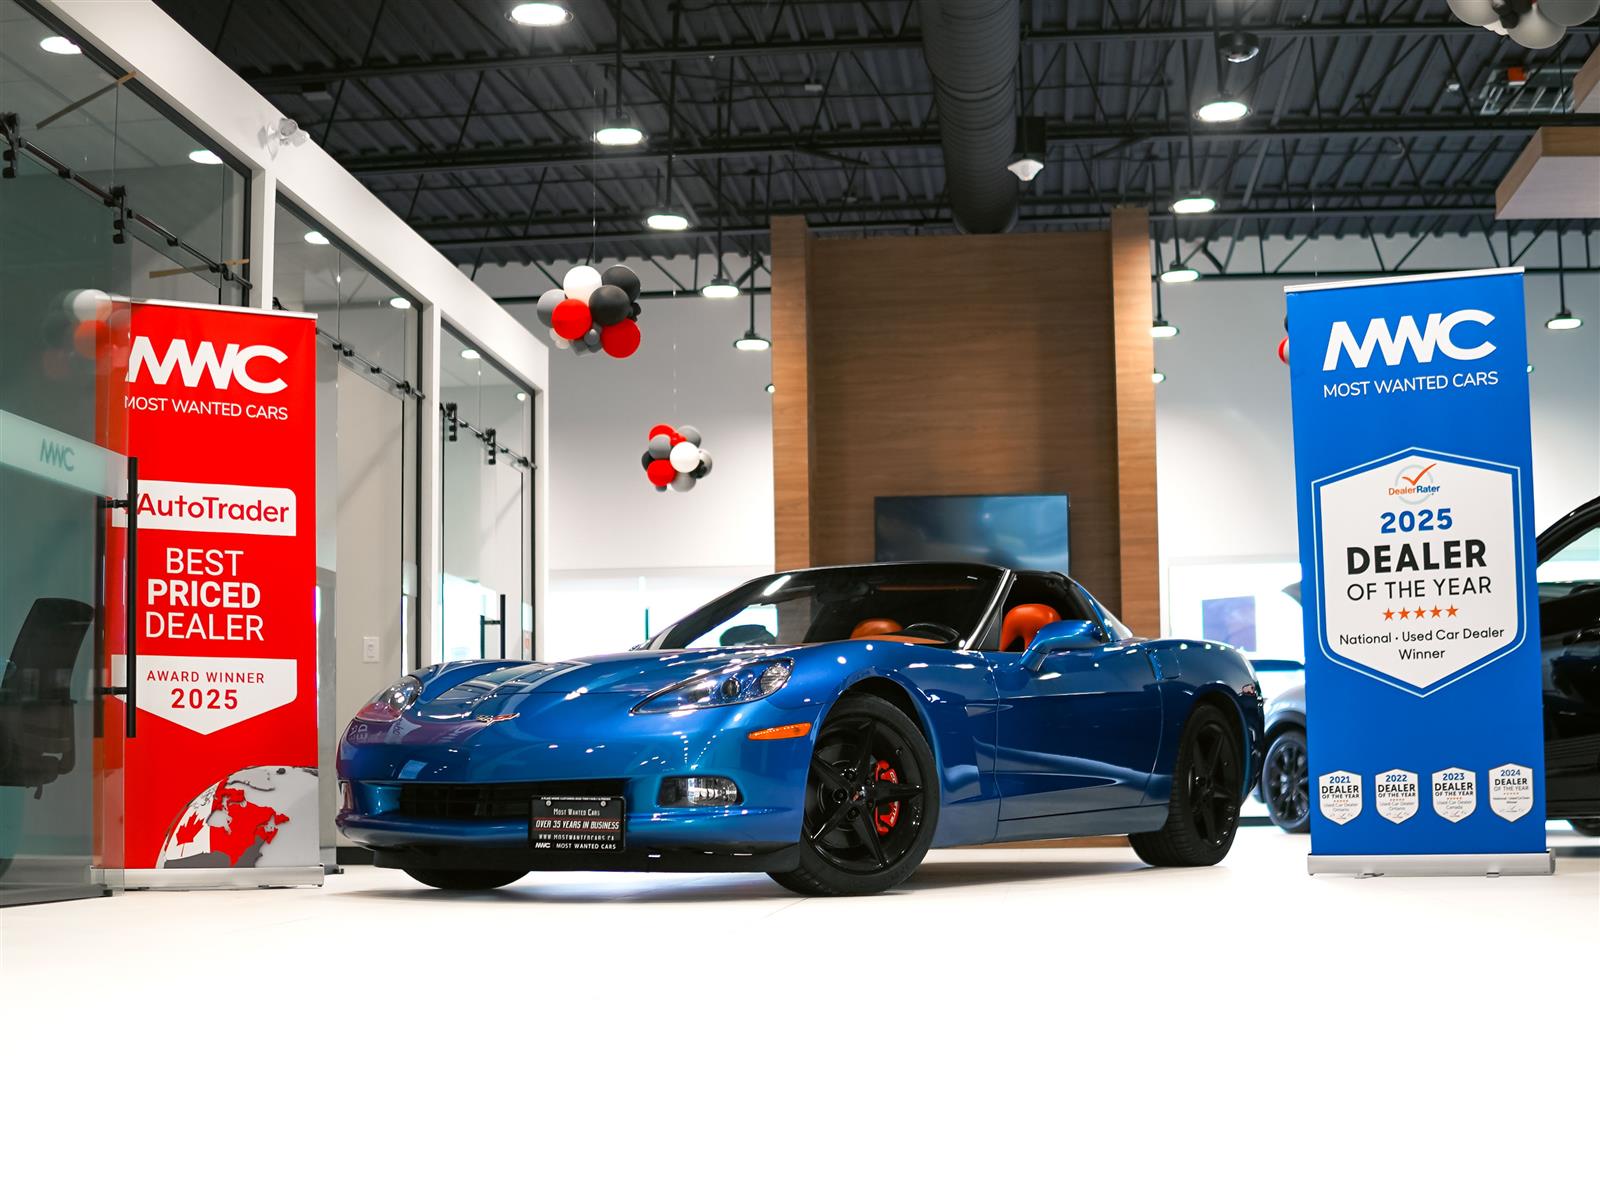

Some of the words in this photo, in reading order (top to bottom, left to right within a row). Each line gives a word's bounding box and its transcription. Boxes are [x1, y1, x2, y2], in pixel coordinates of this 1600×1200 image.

[1322, 308, 1497, 371] MWC
[124, 335, 289, 394] MWC
[1323, 381, 1370, 398] MOST
[1374, 375, 1448, 395] WANTED
[1452, 370, 1499, 388] CARS
[124, 395, 168, 411] MOST
[171, 398, 242, 417] WANTED
[246, 404, 289, 420] CARS
[40, 438, 75, 472] MWC
[1388, 484, 1440, 496] DealerRater
[137, 493, 290, 523] AutoTrader
[1380, 508, 1453, 534] 2025
[166, 547, 244, 577] BEST
[1346, 539, 1487, 575] DEALER
[147, 578, 261, 609] PRICED
[1347, 582, 1377, 601] OF
[1384, 579, 1426, 600] THE
[1433, 576, 1492, 597] YEAR
[145, 611, 265, 642] DEALER
[1339, 632, 1392, 646] National
[1402, 630, 1433, 643] Used
[1435, 628, 1460, 641] Car
[1463, 627, 1505, 640] Dealer
[1398, 649, 1446, 661] Winner
[146, 670, 200, 682] AWARD
[206, 671, 265, 684] WINNER
[171, 688, 238, 710] 2025
[1329, 776, 1351, 784] 2021
[1385, 774, 1408, 782] 2022
[1442, 773, 1465, 781] 2023
[1494, 778, 1528, 786] DEALER
[1500, 769, 1521, 777] 2024
[1321, 785, 1359, 794] DEALER
[1378, 784, 1416, 793] DEALER
[1434, 782, 1473, 791] DEALER
[535, 820, 552, 828] OVER
[552, 820, 561, 829] 35
[562, 820, 581, 829] YEARS
[582, 821, 590, 829] IN
[590, 821, 620, 830] BUSINESS
